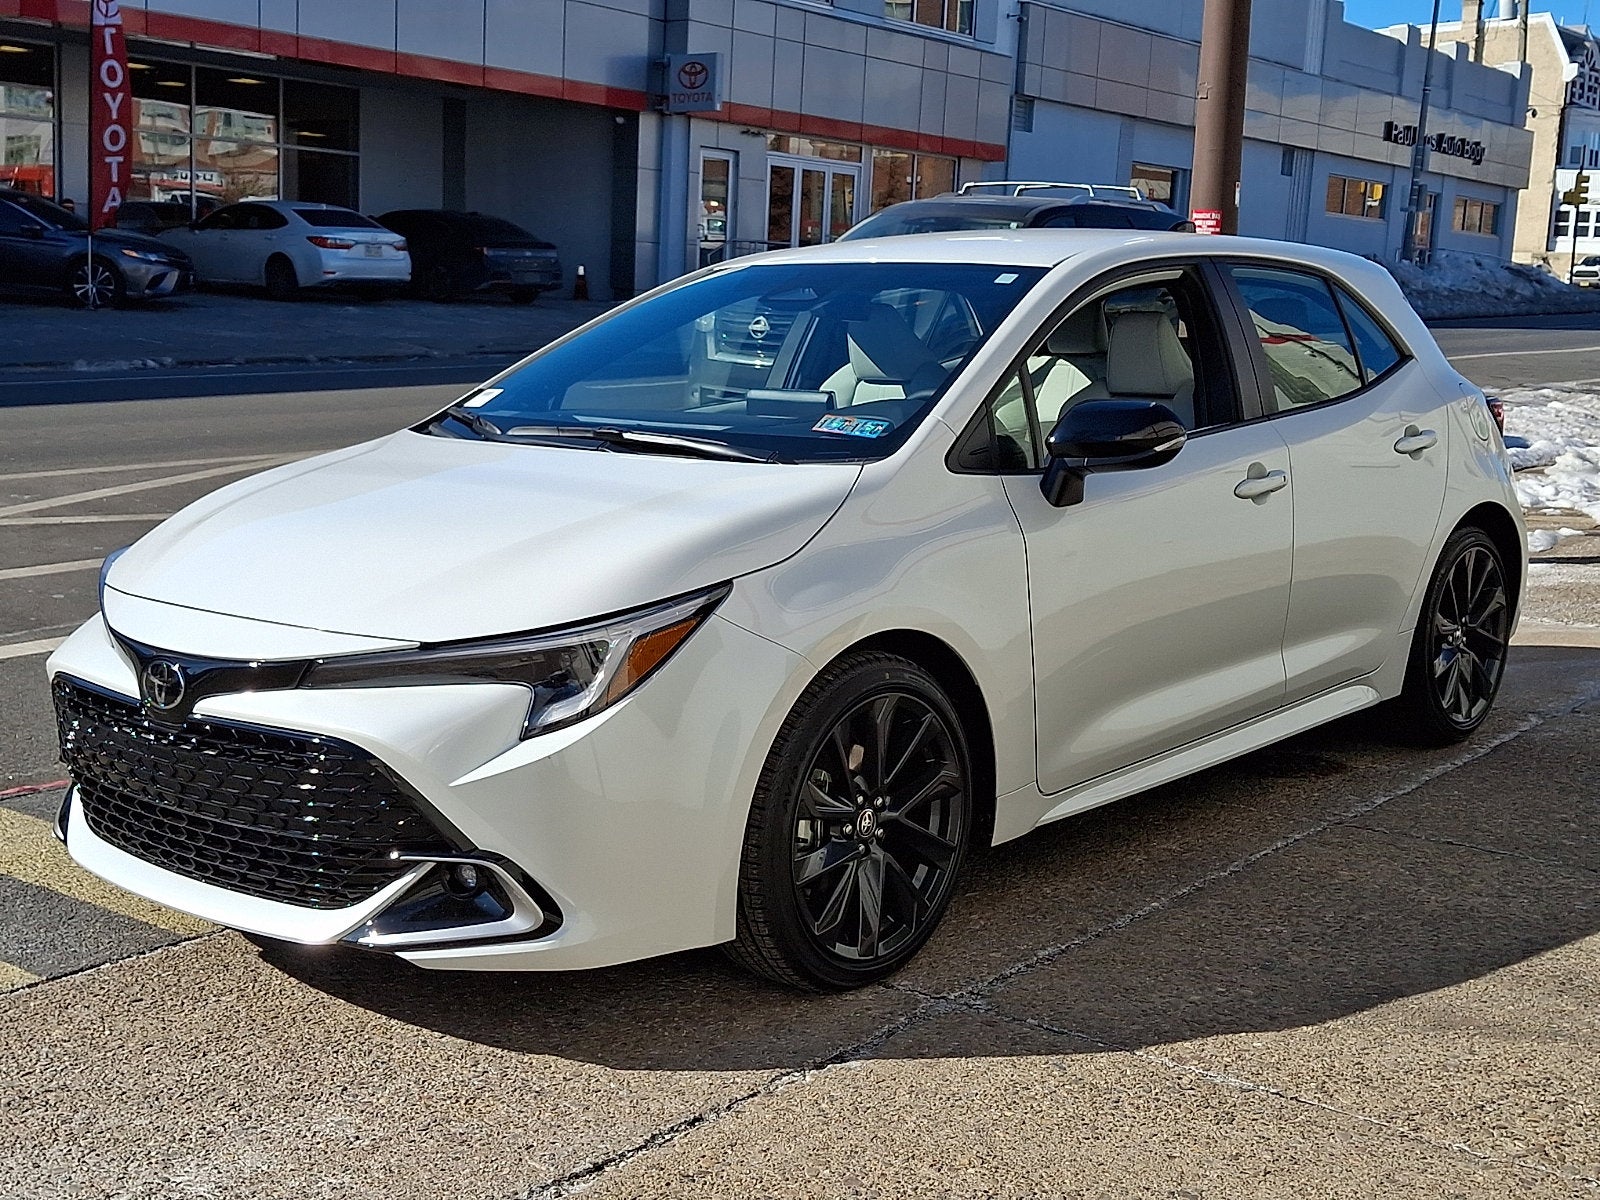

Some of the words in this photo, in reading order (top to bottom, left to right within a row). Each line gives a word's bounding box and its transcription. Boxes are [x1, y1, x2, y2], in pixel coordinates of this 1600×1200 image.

[672, 91, 714, 104] TOYOTA
[100, 27, 127, 213] TOYOTA
[1386, 121, 1418, 146] Paul
[1440, 133, 1463, 156] Auto
[1463, 138, 1487, 165] Body
